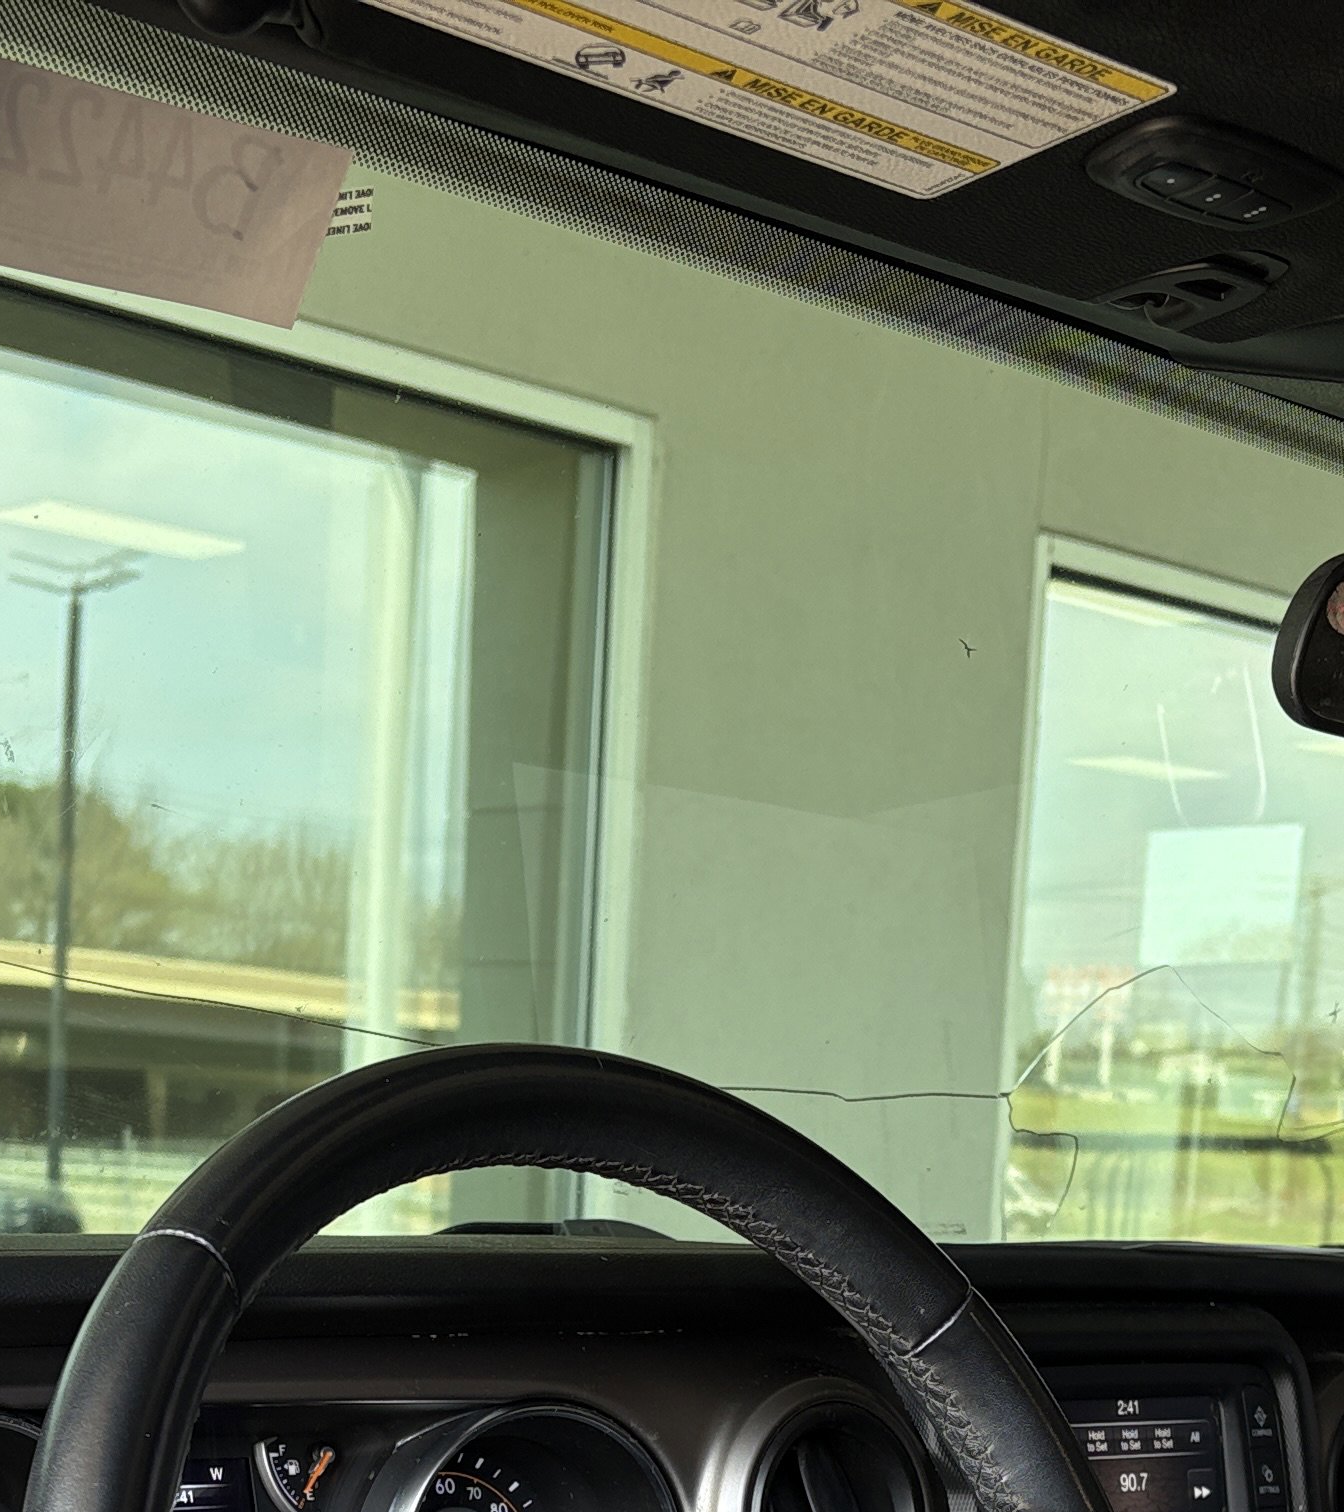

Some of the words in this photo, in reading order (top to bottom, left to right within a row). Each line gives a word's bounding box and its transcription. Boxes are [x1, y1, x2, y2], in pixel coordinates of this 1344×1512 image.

[955, 12, 1005, 39] MISE
[1003, 32, 1041, 54] EN
[1035, 48, 1112, 80] GARDE
[744, 78, 804, 105] MISE
[798, 98, 831, 117] EN
[831, 110, 910, 144] GARDE
[1117, 1399, 1140, 1416] 2:41
[1088, 1430, 1105, 1441] Hold
[1122, 1428, 1138, 1440] Hold
[1154, 1427, 1171, 1438] Hold
[1190, 1431, 1201, 1443] All
[1095, 1441, 1108, 1453] Set
[1129, 1439, 1141, 1451] Set
[1161, 1438, 1174, 1450] Set
[278, 1444, 287, 1457] F
[210, 1468, 224, 1482] W
[1119, 1472, 1149, 1492] 90.7
[435, 1478, 456, 1495] 60
[466, 1485, 482, 1501] 70
